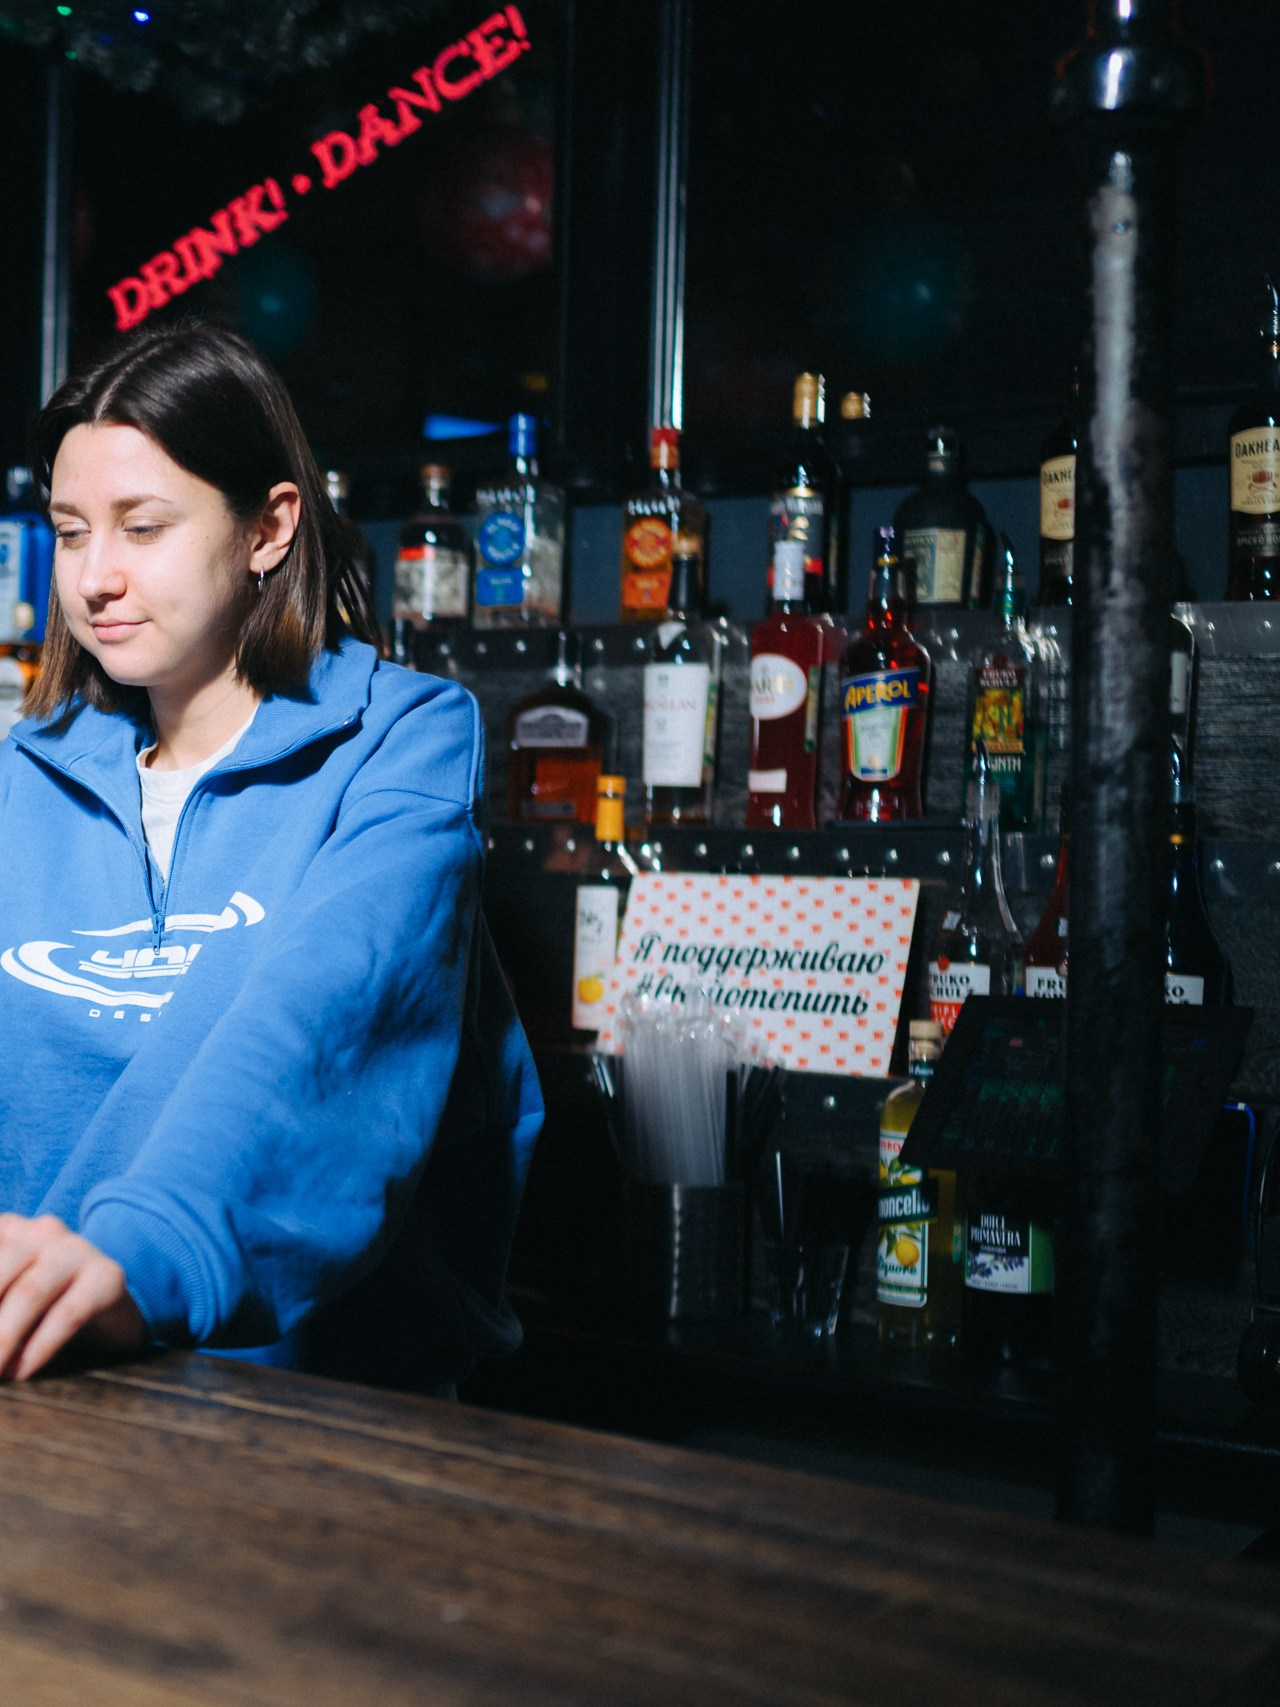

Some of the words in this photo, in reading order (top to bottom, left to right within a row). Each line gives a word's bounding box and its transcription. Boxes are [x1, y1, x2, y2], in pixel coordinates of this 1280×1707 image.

[107, 177, 288, 332] DRINK!
[311, 4, 531, 189] DANCE!
[845, 680, 912, 712] APEROL
[633, 933, 661, 962] Я
[663, 941, 885, 976] поддерживаю
